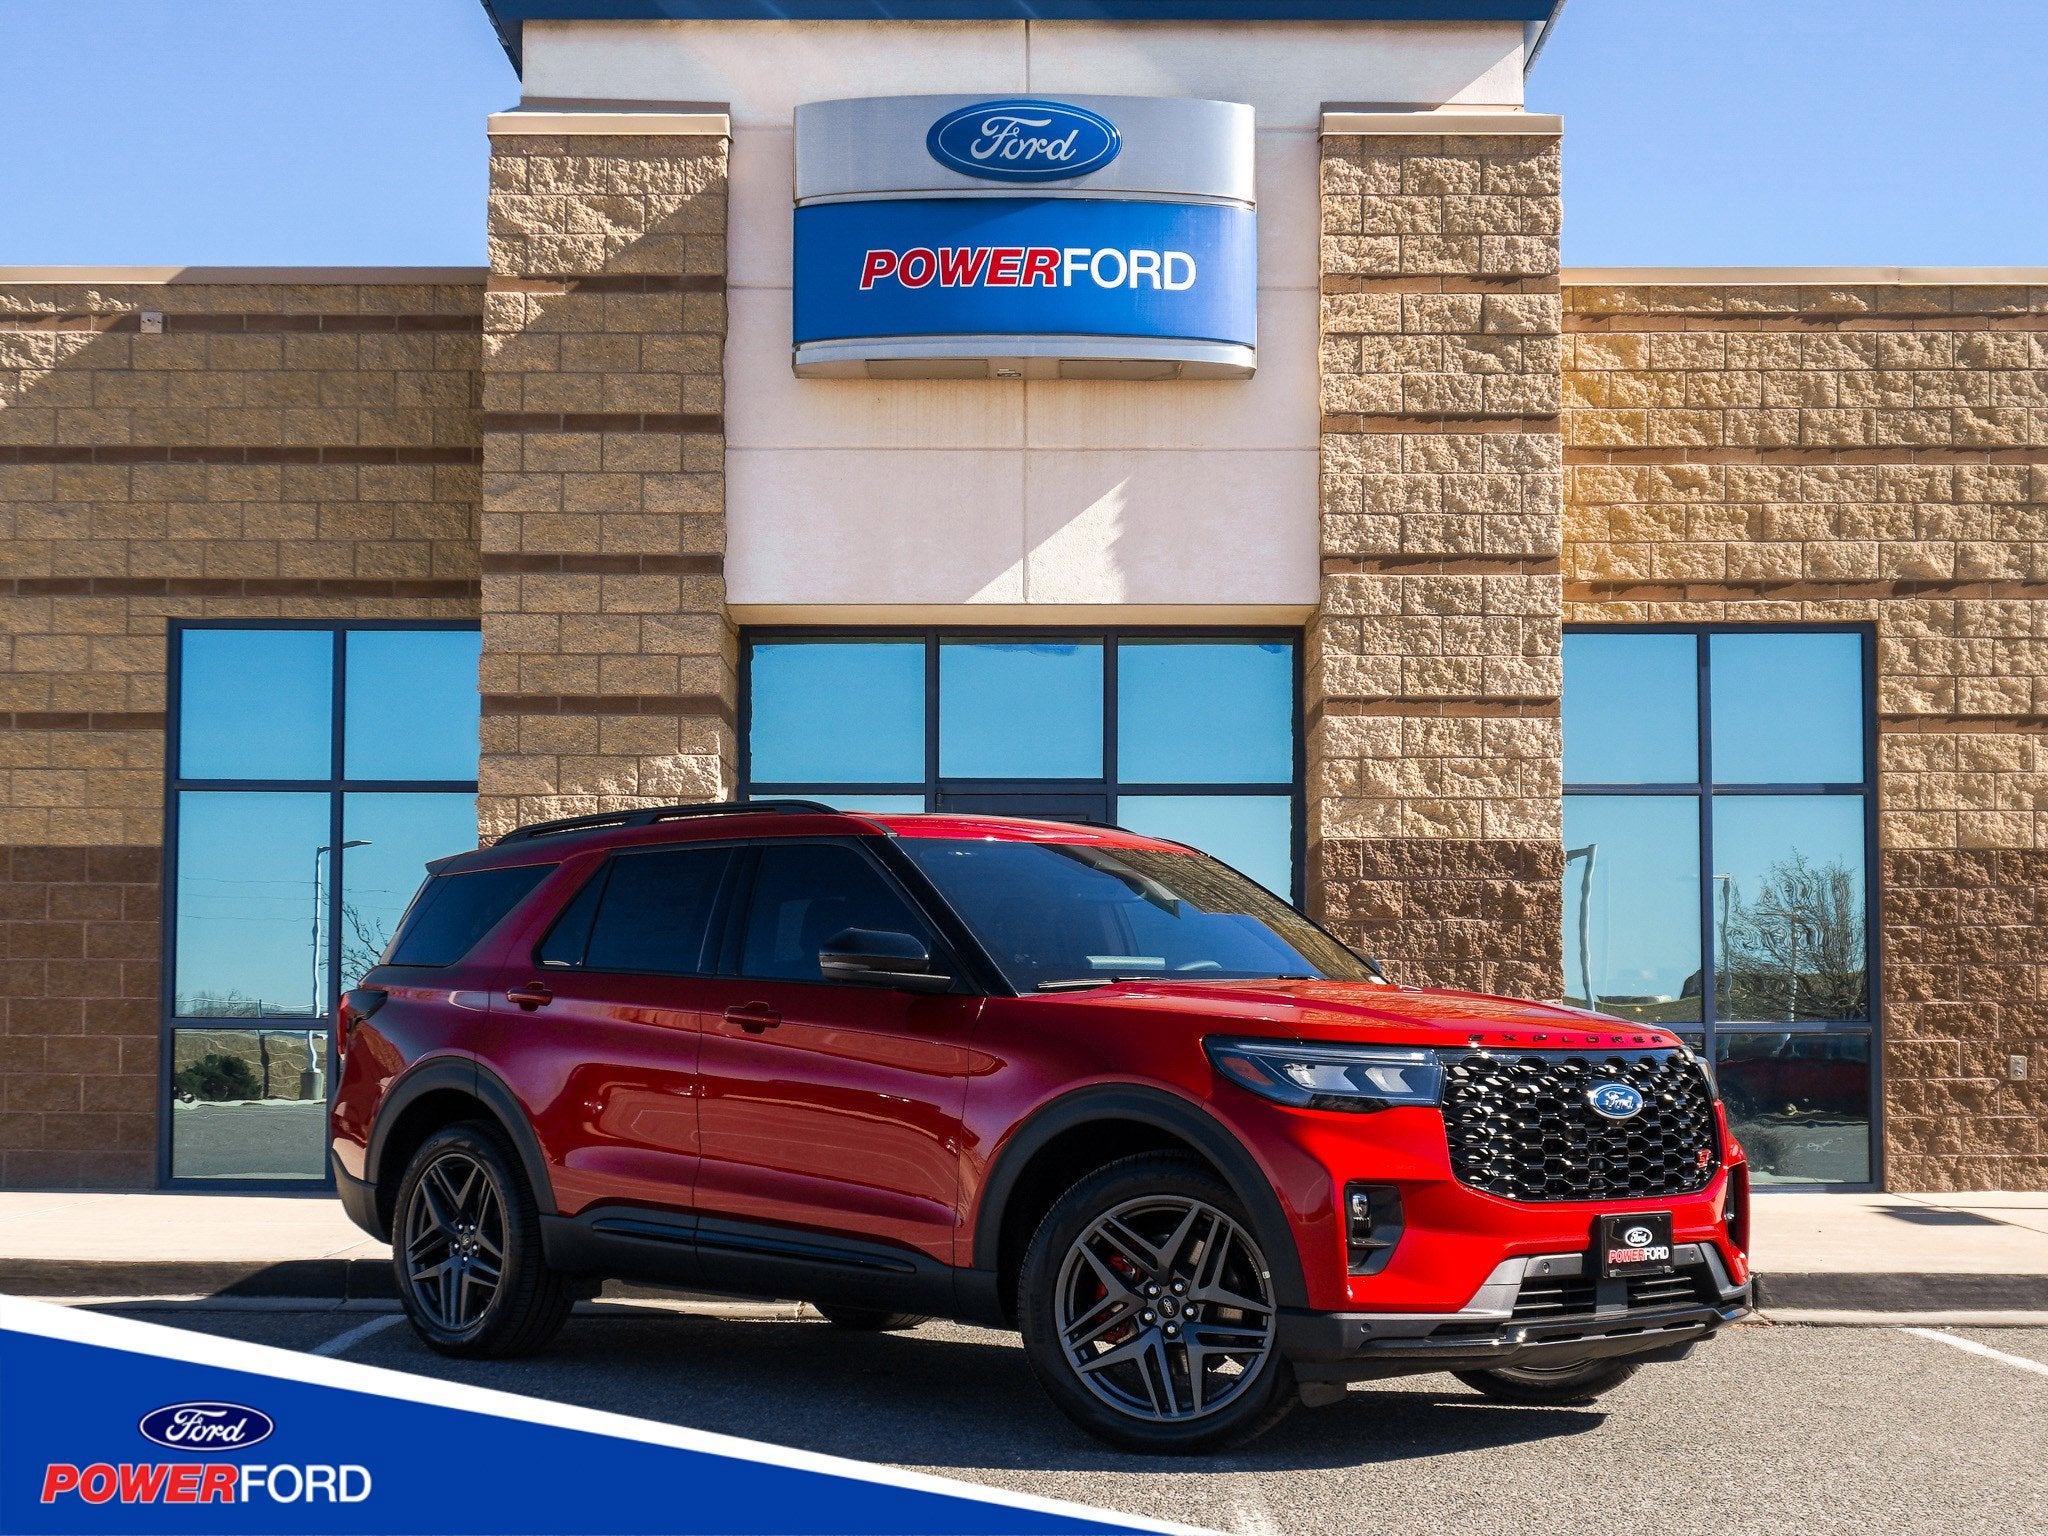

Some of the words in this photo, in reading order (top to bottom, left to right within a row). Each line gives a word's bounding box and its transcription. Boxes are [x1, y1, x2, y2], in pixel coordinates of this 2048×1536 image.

[970, 116, 1078, 161] Ford
[859, 247, 1196, 291] POWERFORD
[1468, 1034, 1665, 1043] EXPLORER
[1605, 1091, 1634, 1110] Ford
[1608, 1246, 1669, 1263] POWERFORD
